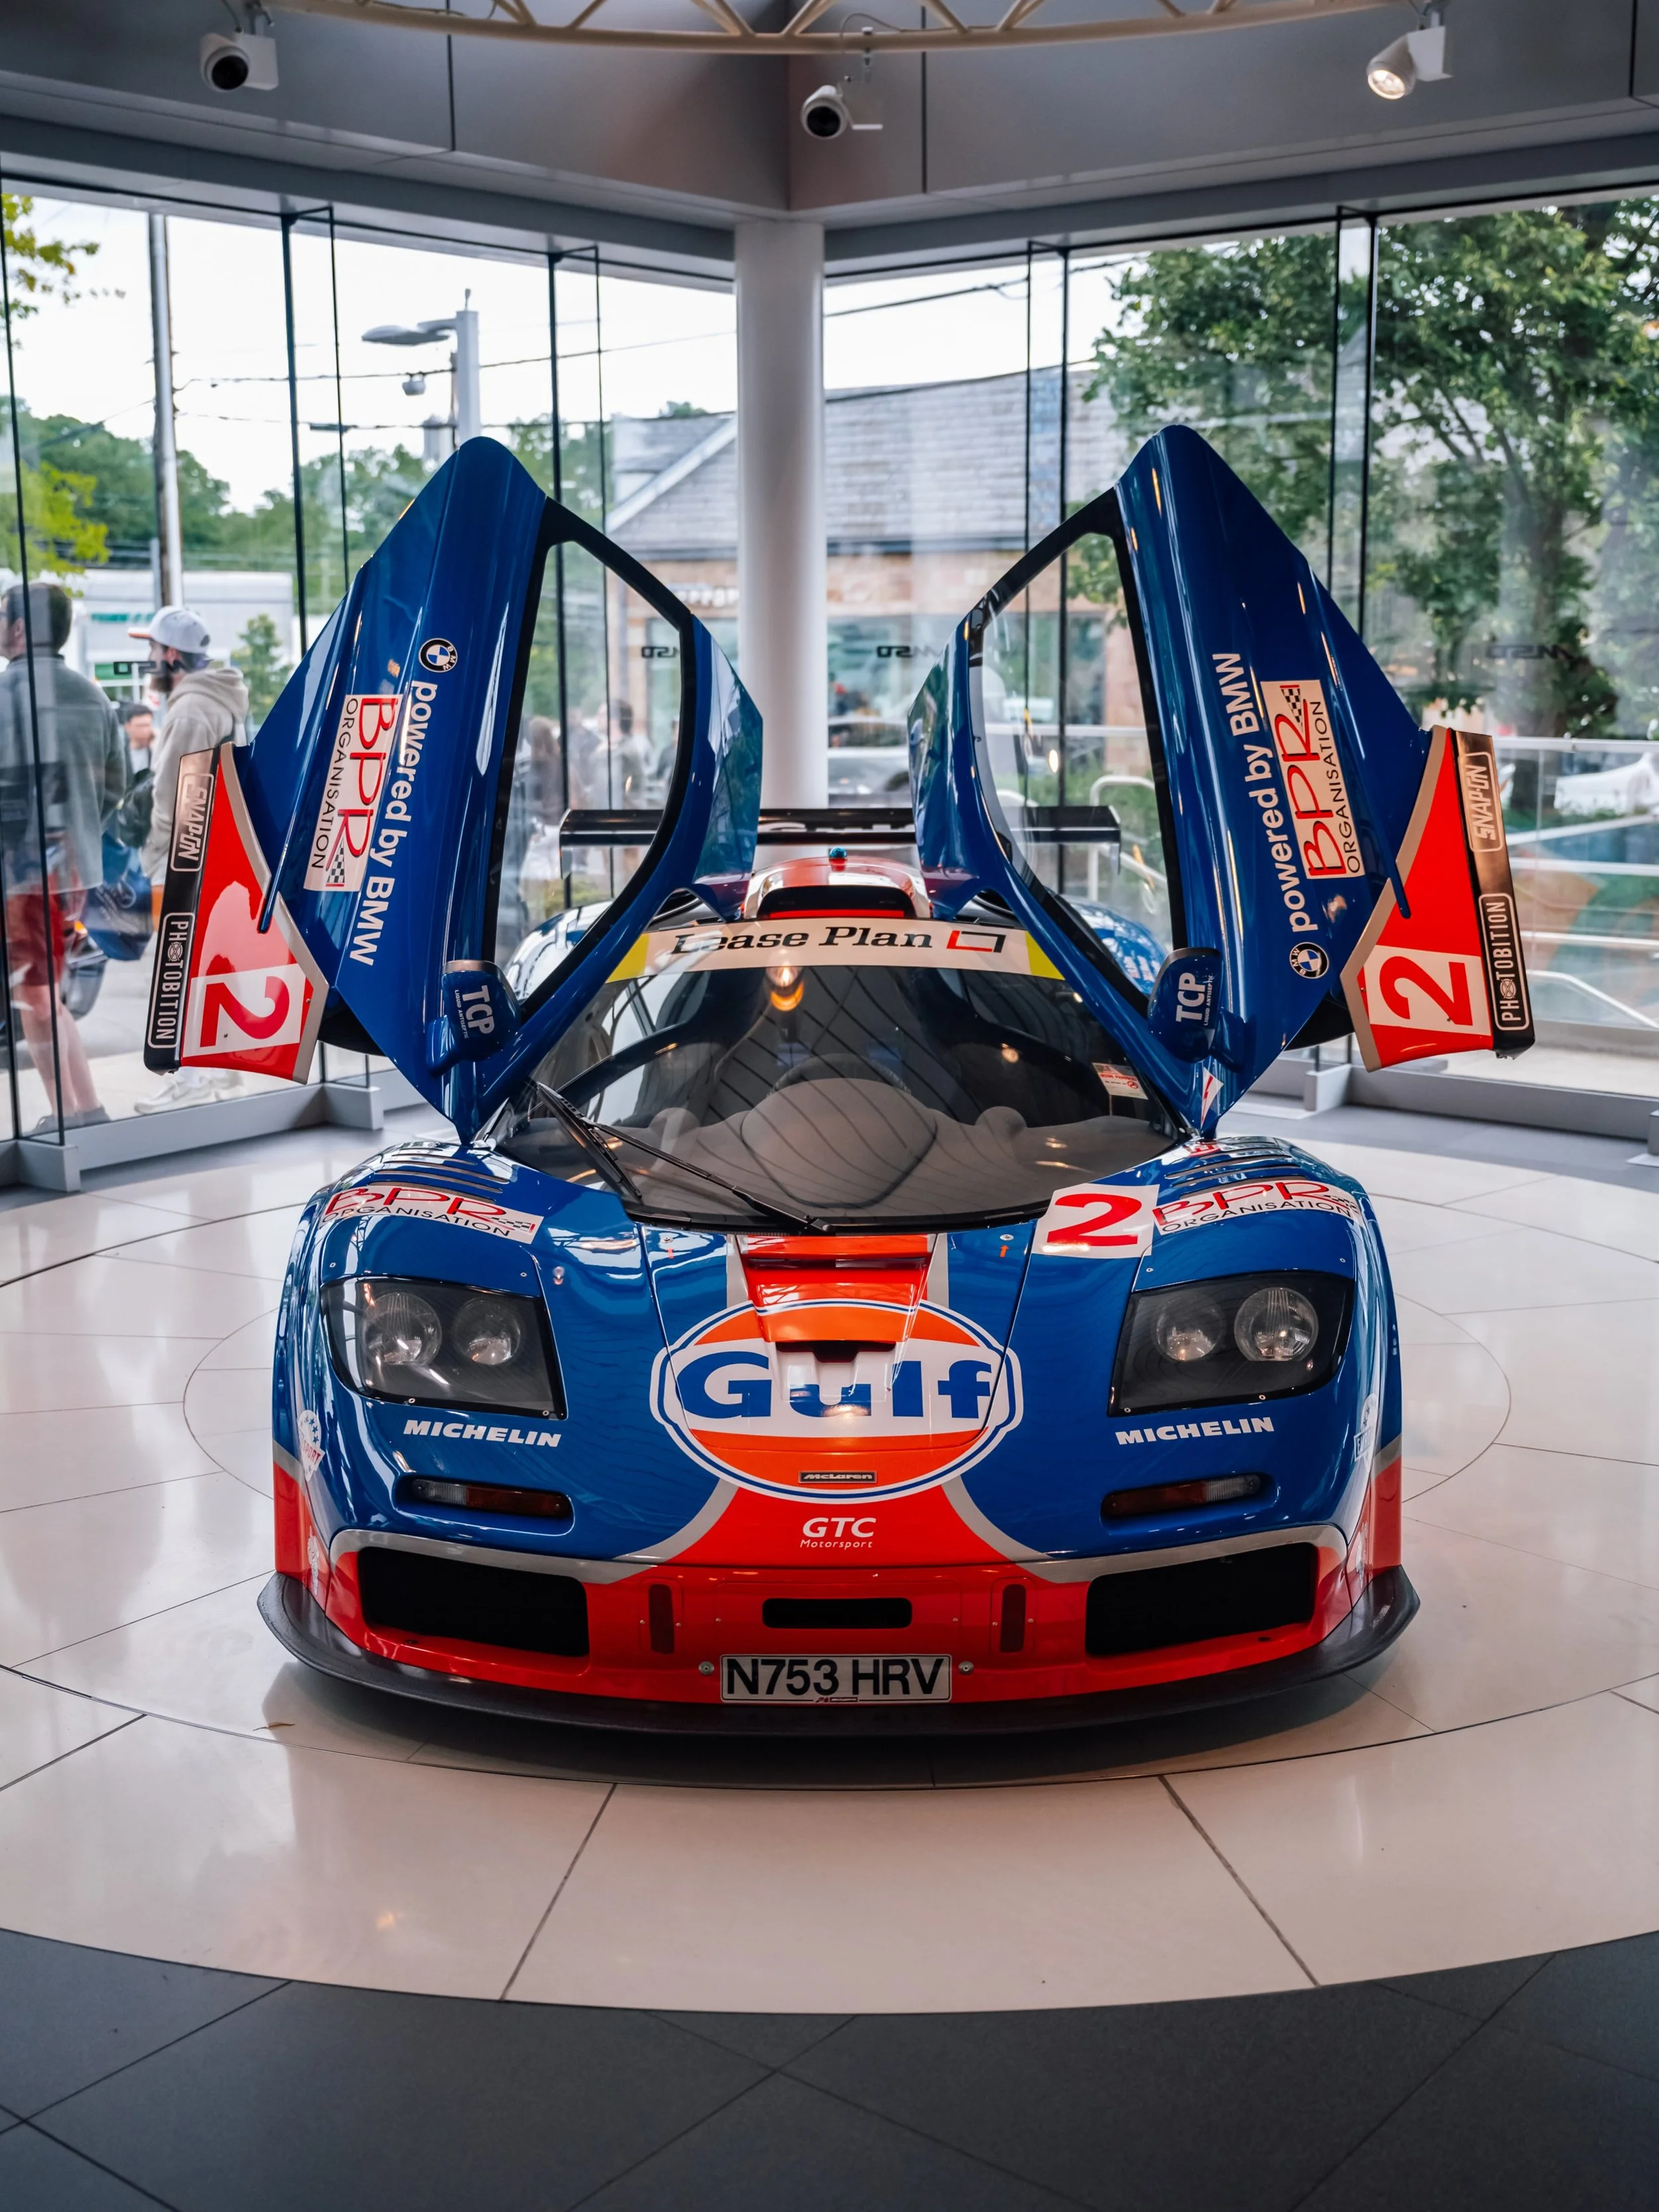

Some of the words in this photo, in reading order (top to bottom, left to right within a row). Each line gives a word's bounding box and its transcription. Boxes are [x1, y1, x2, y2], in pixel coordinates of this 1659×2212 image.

[1212, 653, 1260, 737] BMW
[384, 680, 437, 821] powered
[1244, 745, 1273, 782] by
[311, 698, 358, 869] ORGANISATION
[326, 697, 399, 869] BPR
[1274, 699, 1346, 877] BPR
[1309, 701, 1360, 873] ORGANISATION
[370, 826, 407, 867] by
[1256, 786, 1318, 932] powered
[350, 876, 395, 966] BMW
[670, 931, 808, 954] Lease
[818, 926, 932, 949] Plan
[200, 976, 289, 1047] 2
[462, 985, 495, 1034] TCP
[1176, 972, 1205, 1022] TCP
[1380, 955, 1473, 1026] 2
[323, 1206, 510, 1237] ORGANISATION
[325, 1187, 515, 1231] BPR
[1046, 1193, 1142, 1246] 2
[1152, 1181, 1349, 1226] BPR
[1162, 1200, 1351, 1232] ORGANISATION
[676, 1351, 993, 1419] Gulf
[403, 1420, 561, 1447] MICHELIN
[1116, 1416, 1274, 1445] MICHELIN
[800, 1539, 873, 1550] Motorsport
[802, 1517, 877, 1538] GTC
[727, 1659, 839, 1696] N753
[851, 1659, 945, 1696] HRV
